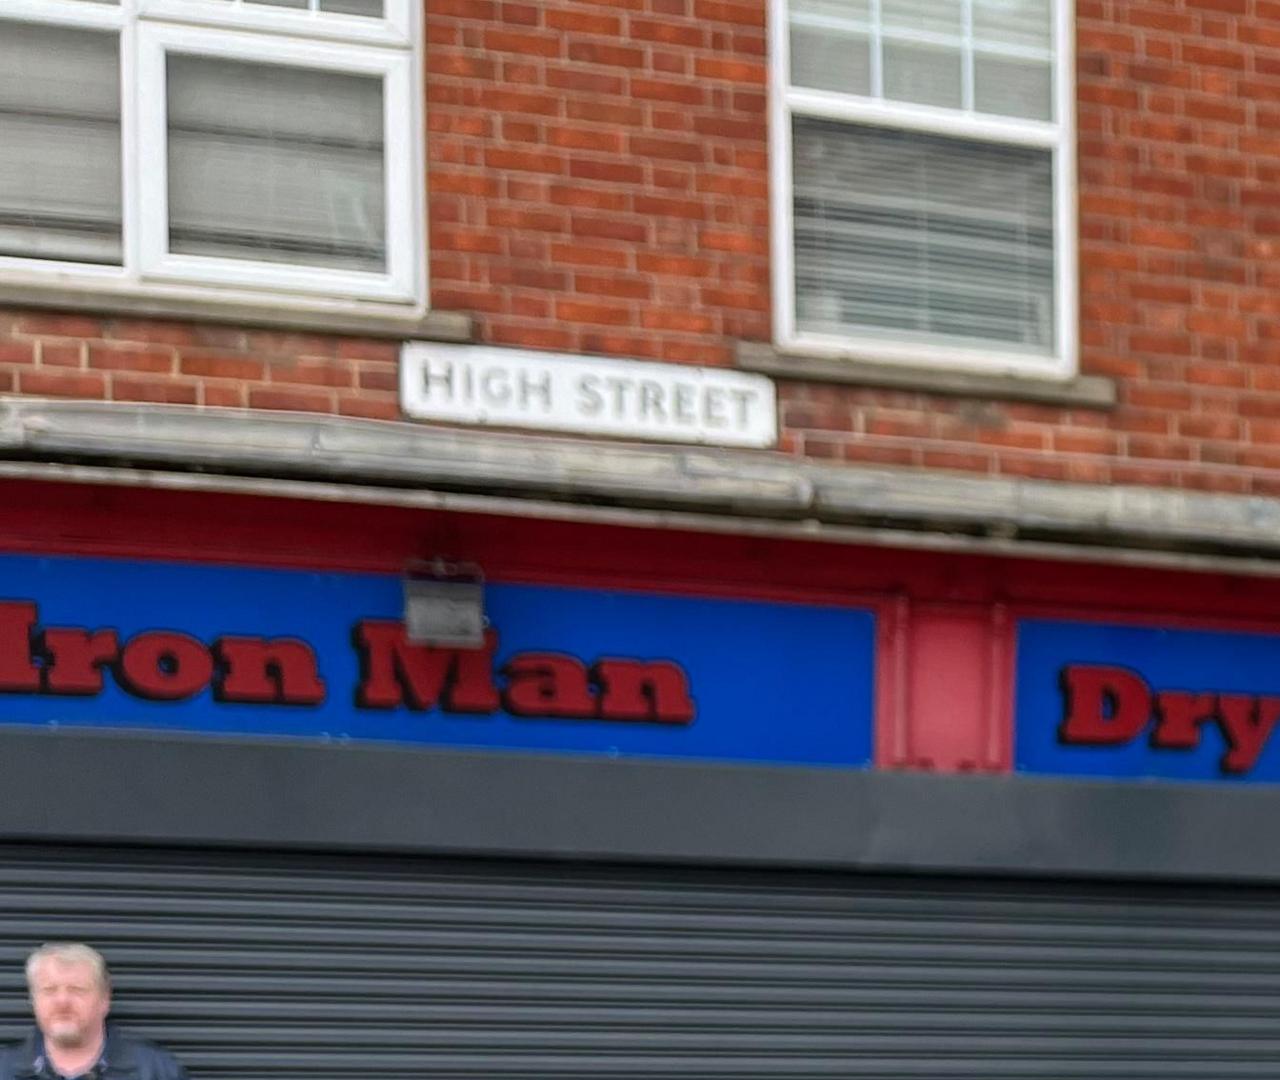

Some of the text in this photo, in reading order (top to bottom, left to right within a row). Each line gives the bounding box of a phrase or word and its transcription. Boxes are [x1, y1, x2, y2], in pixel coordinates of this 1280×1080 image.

[421, 359, 760, 431] HIGH STREET
[354, 618, 696, 724] Man
